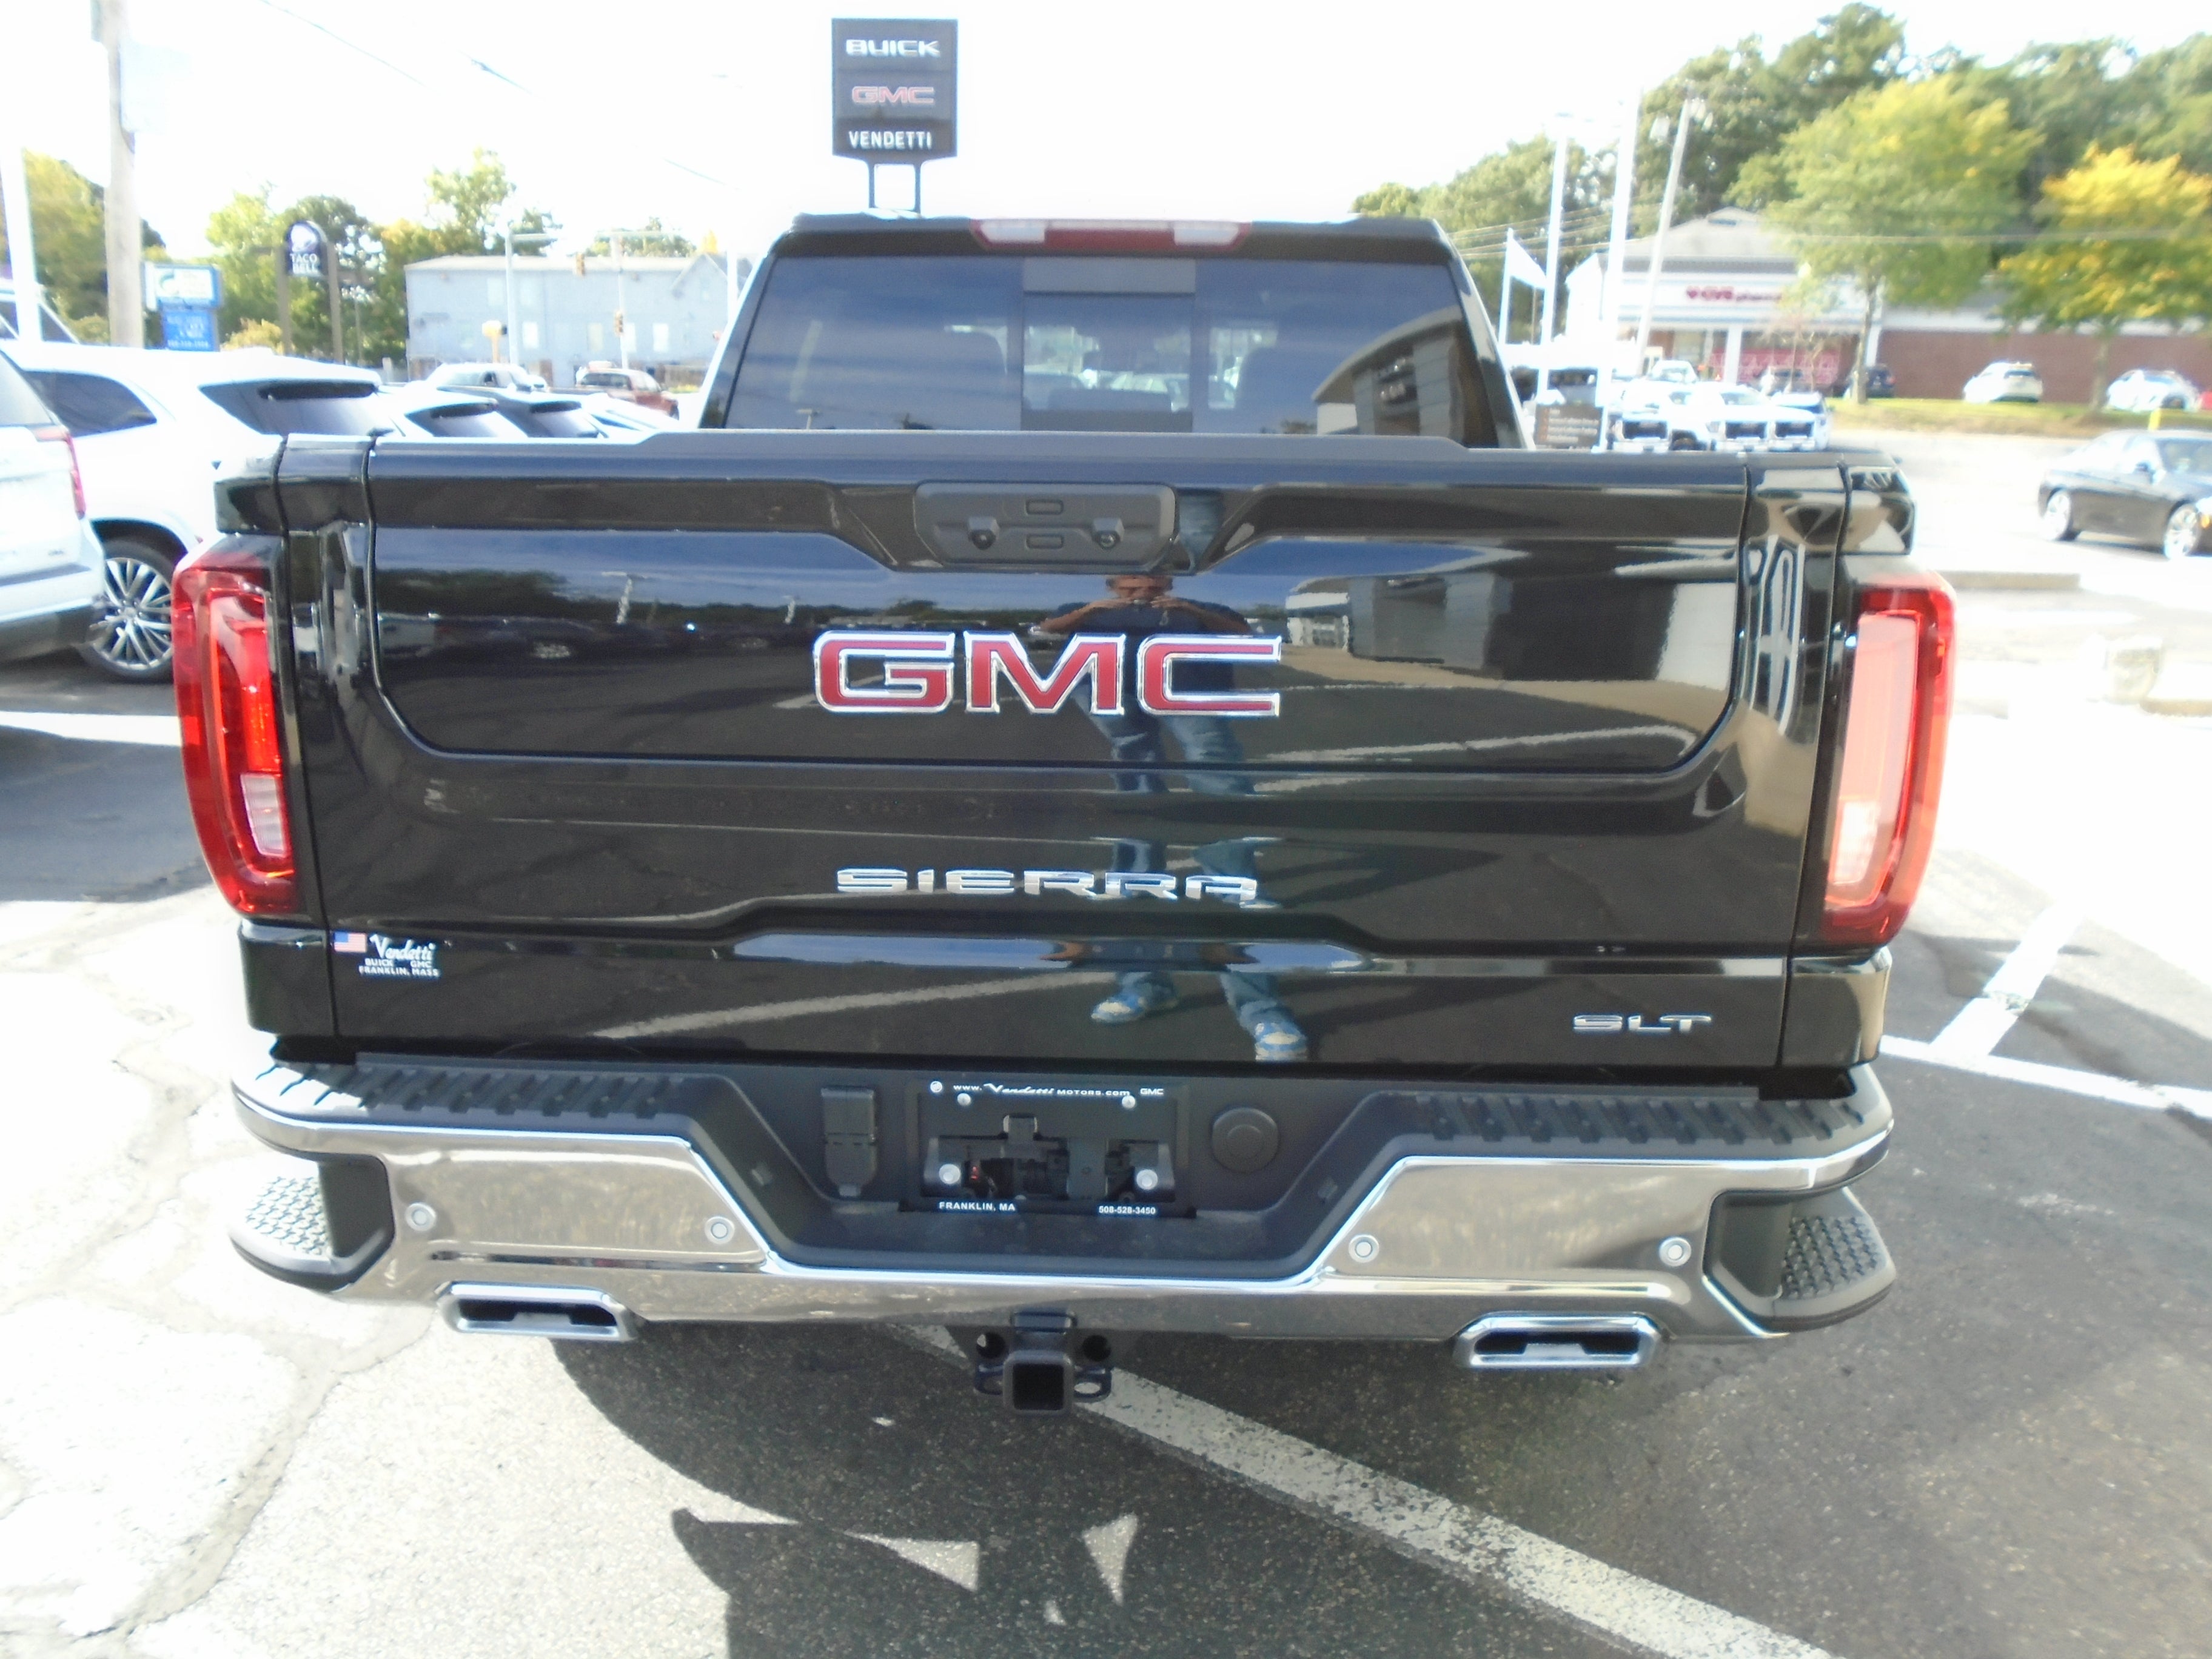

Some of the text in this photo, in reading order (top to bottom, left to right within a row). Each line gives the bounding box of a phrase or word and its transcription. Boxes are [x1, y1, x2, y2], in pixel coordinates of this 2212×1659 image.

[846, 39, 940, 57] BUICK
[852, 85, 935, 105] GMC
[848, 130, 932, 149] VENDETTI
[290, 253, 318, 263] TACO
[813, 629, 1282, 717] GMC
[836, 867, 1258, 900] SIERRA
[369, 934, 437, 960] Vendetti
[364, 958, 432, 968] BUICK GMC
[1573, 1014, 1712, 1033] SLT
[939, 1201, 996, 1212] FRANKLIN,
[1098, 1205, 1156, 1215] 508-528-3450
